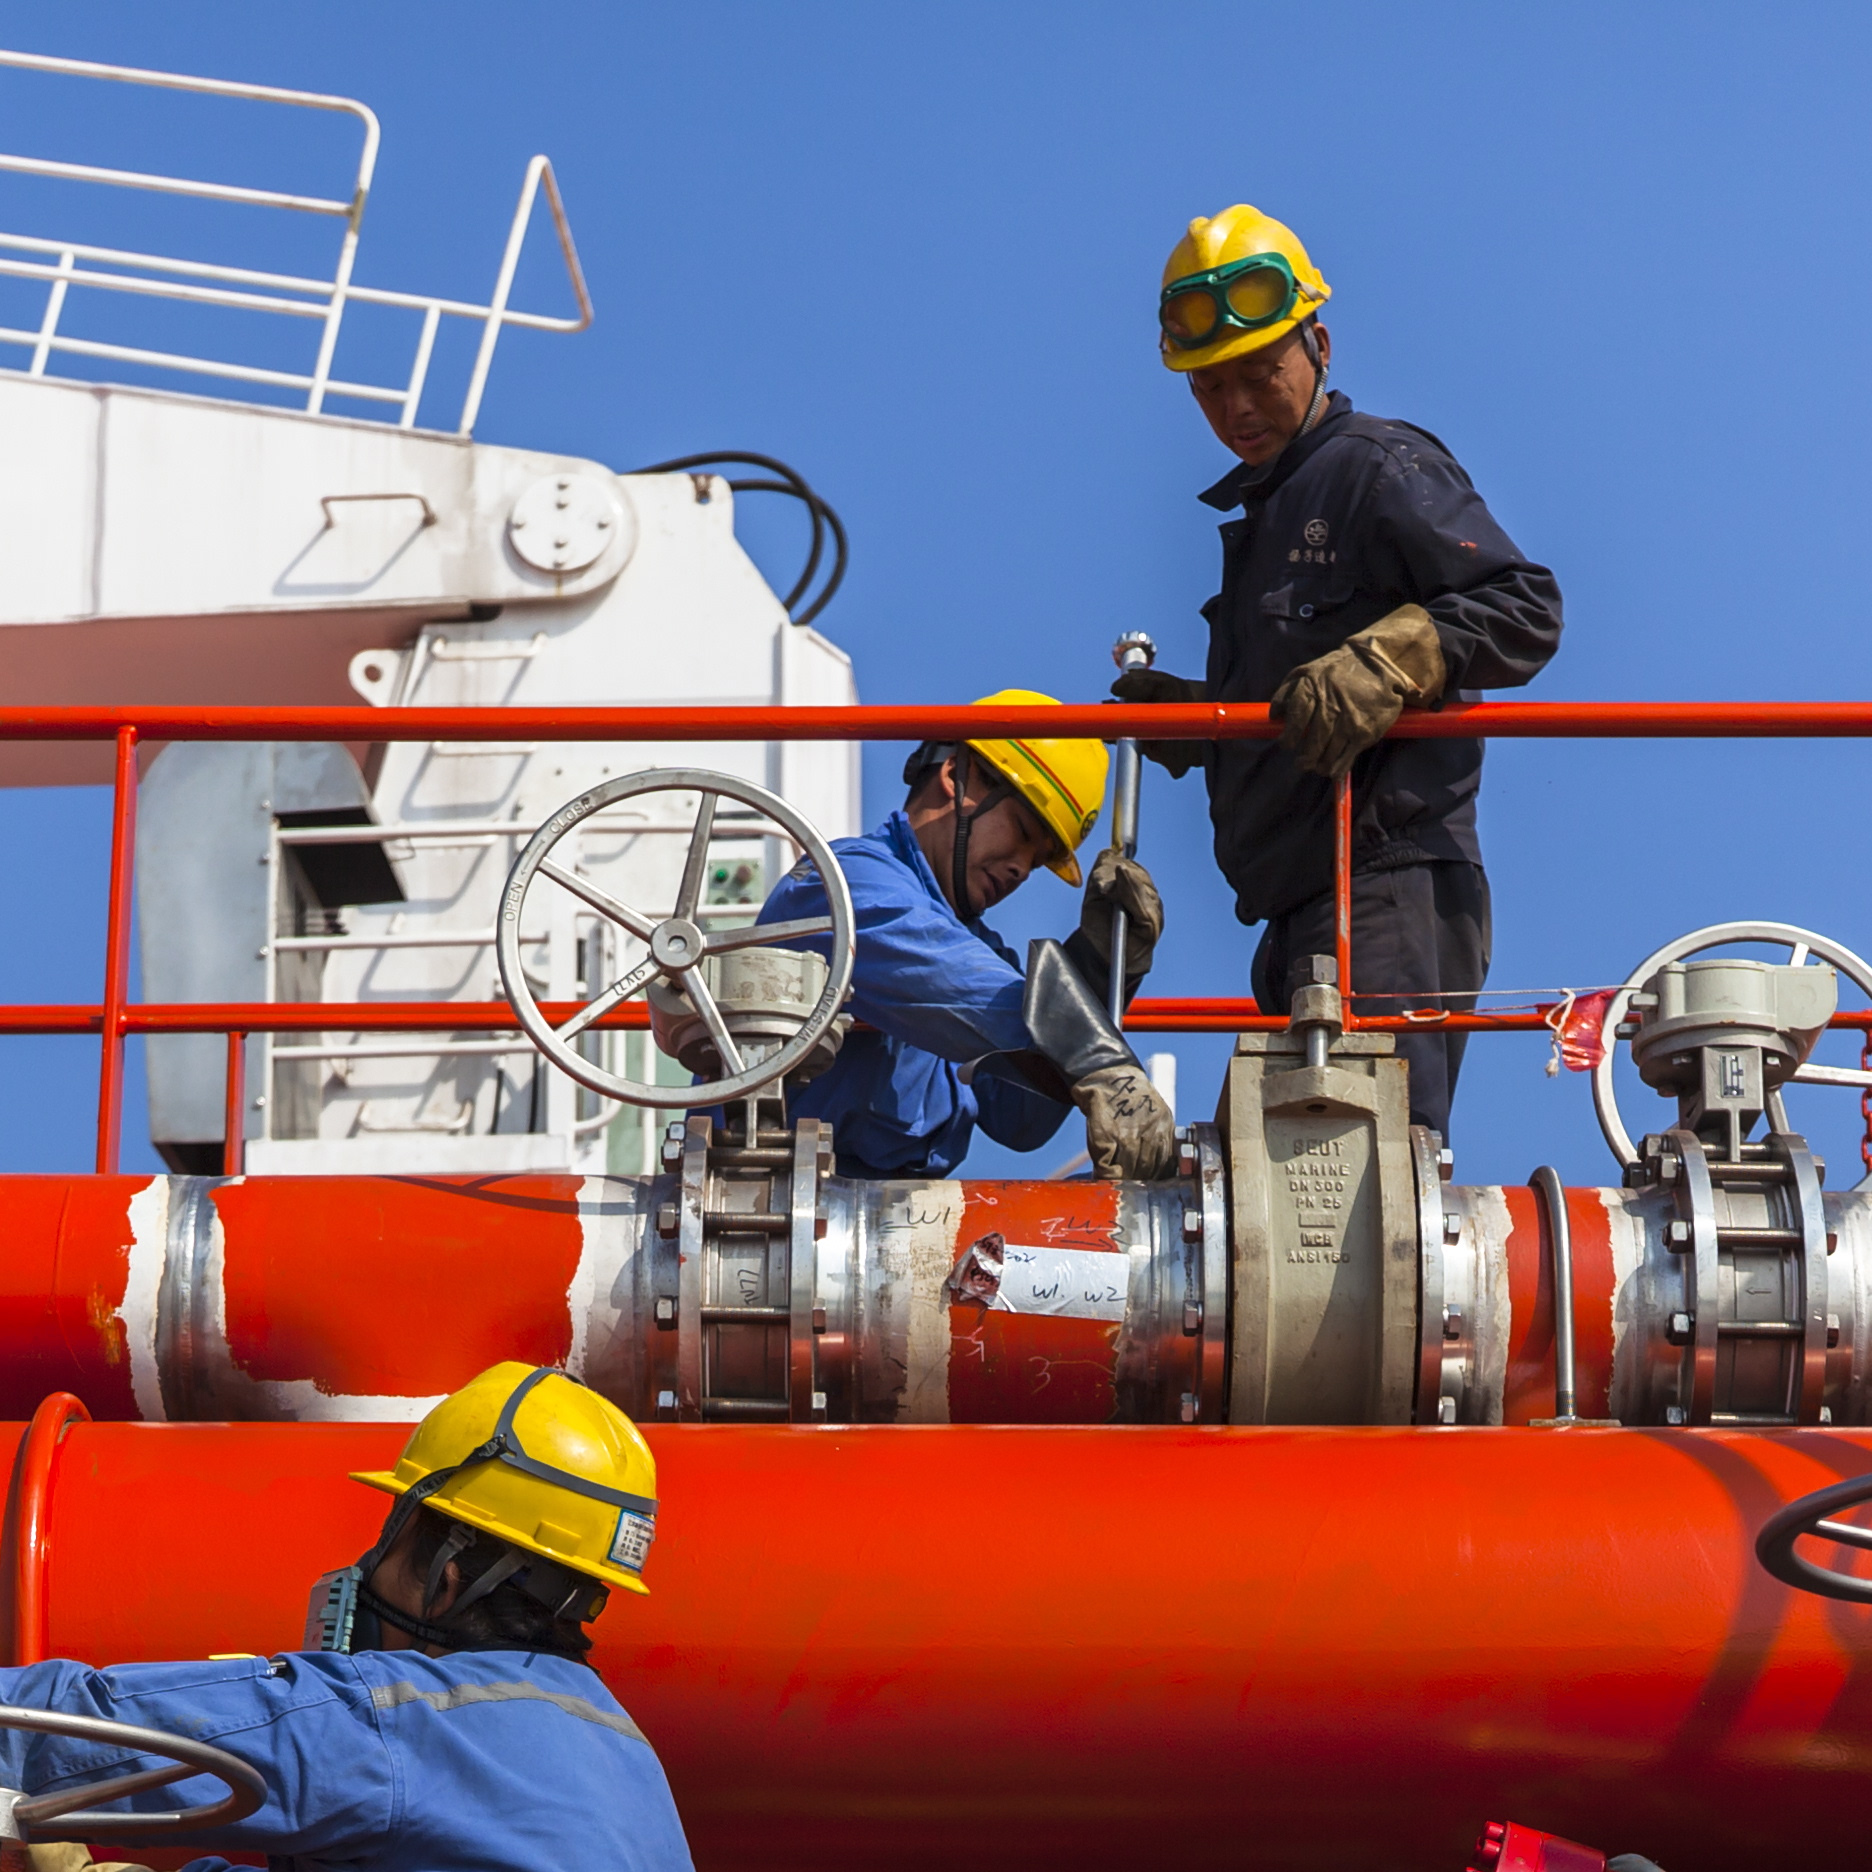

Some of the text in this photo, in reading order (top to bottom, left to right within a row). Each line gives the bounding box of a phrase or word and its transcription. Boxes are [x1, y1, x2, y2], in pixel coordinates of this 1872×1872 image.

[550, 796, 593, 833] CLOSE
[505, 882, 524, 921] OPEN
[797, 986, 839, 1042] WESTAD
[1285, 1163, 1350, 1177] MARINE
[1290, 1180, 1309, 1192] DN
[1296, 1196, 1315, 1209] PN
[1287, 1249, 1321, 1263] ANSI
